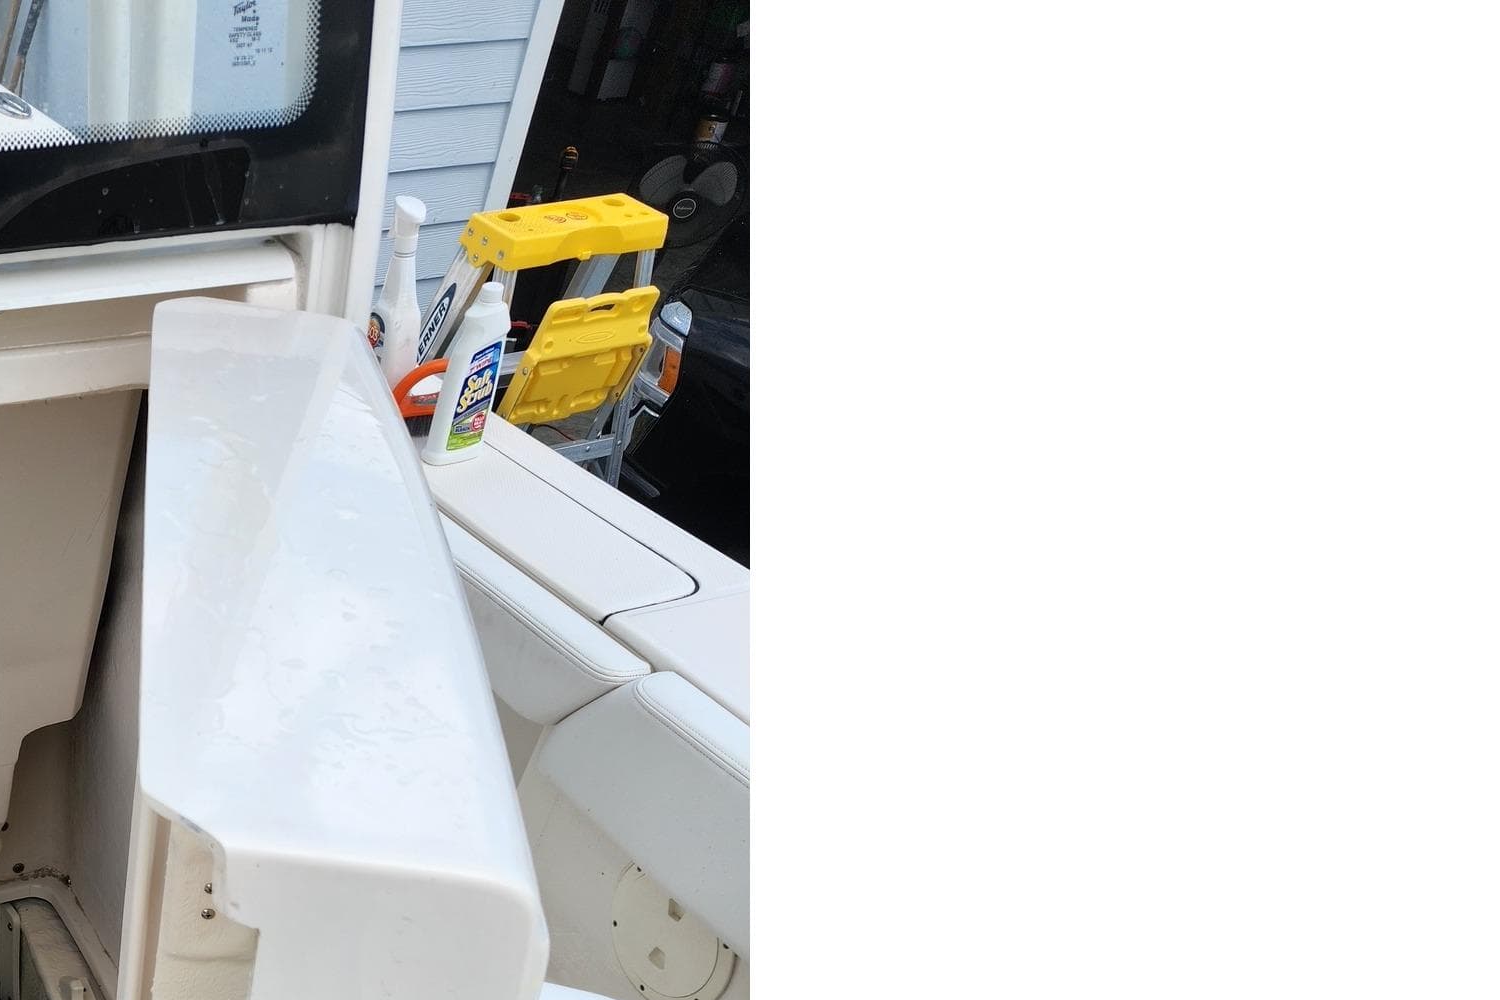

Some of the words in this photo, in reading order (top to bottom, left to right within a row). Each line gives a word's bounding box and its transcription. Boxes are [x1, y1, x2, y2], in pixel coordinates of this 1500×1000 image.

[418, 302, 446, 356] ERNER
[457, 380, 494, 413] Scrub
[467, 368, 493, 392] Soft
